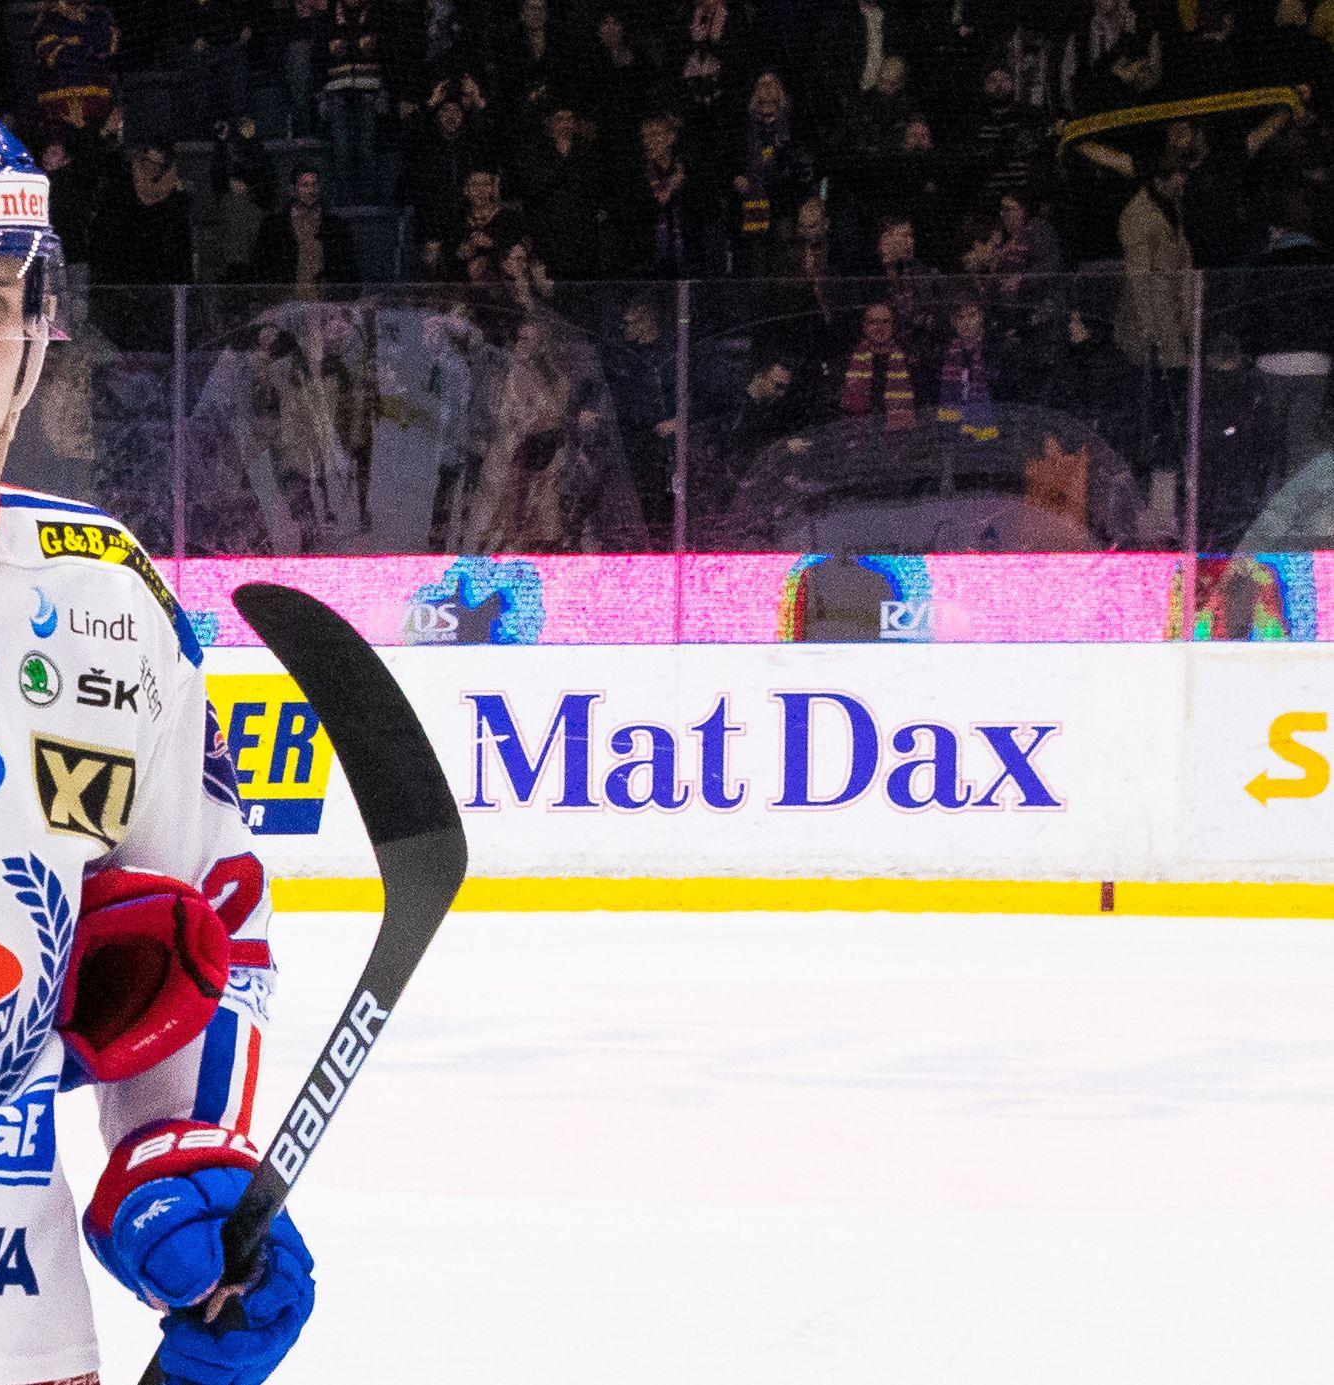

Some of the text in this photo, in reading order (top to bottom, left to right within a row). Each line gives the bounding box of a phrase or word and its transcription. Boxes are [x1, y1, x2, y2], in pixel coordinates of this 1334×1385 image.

[40, 526, 106, 556] G&B
[464, 693, 1062, 809] Mat Dax
